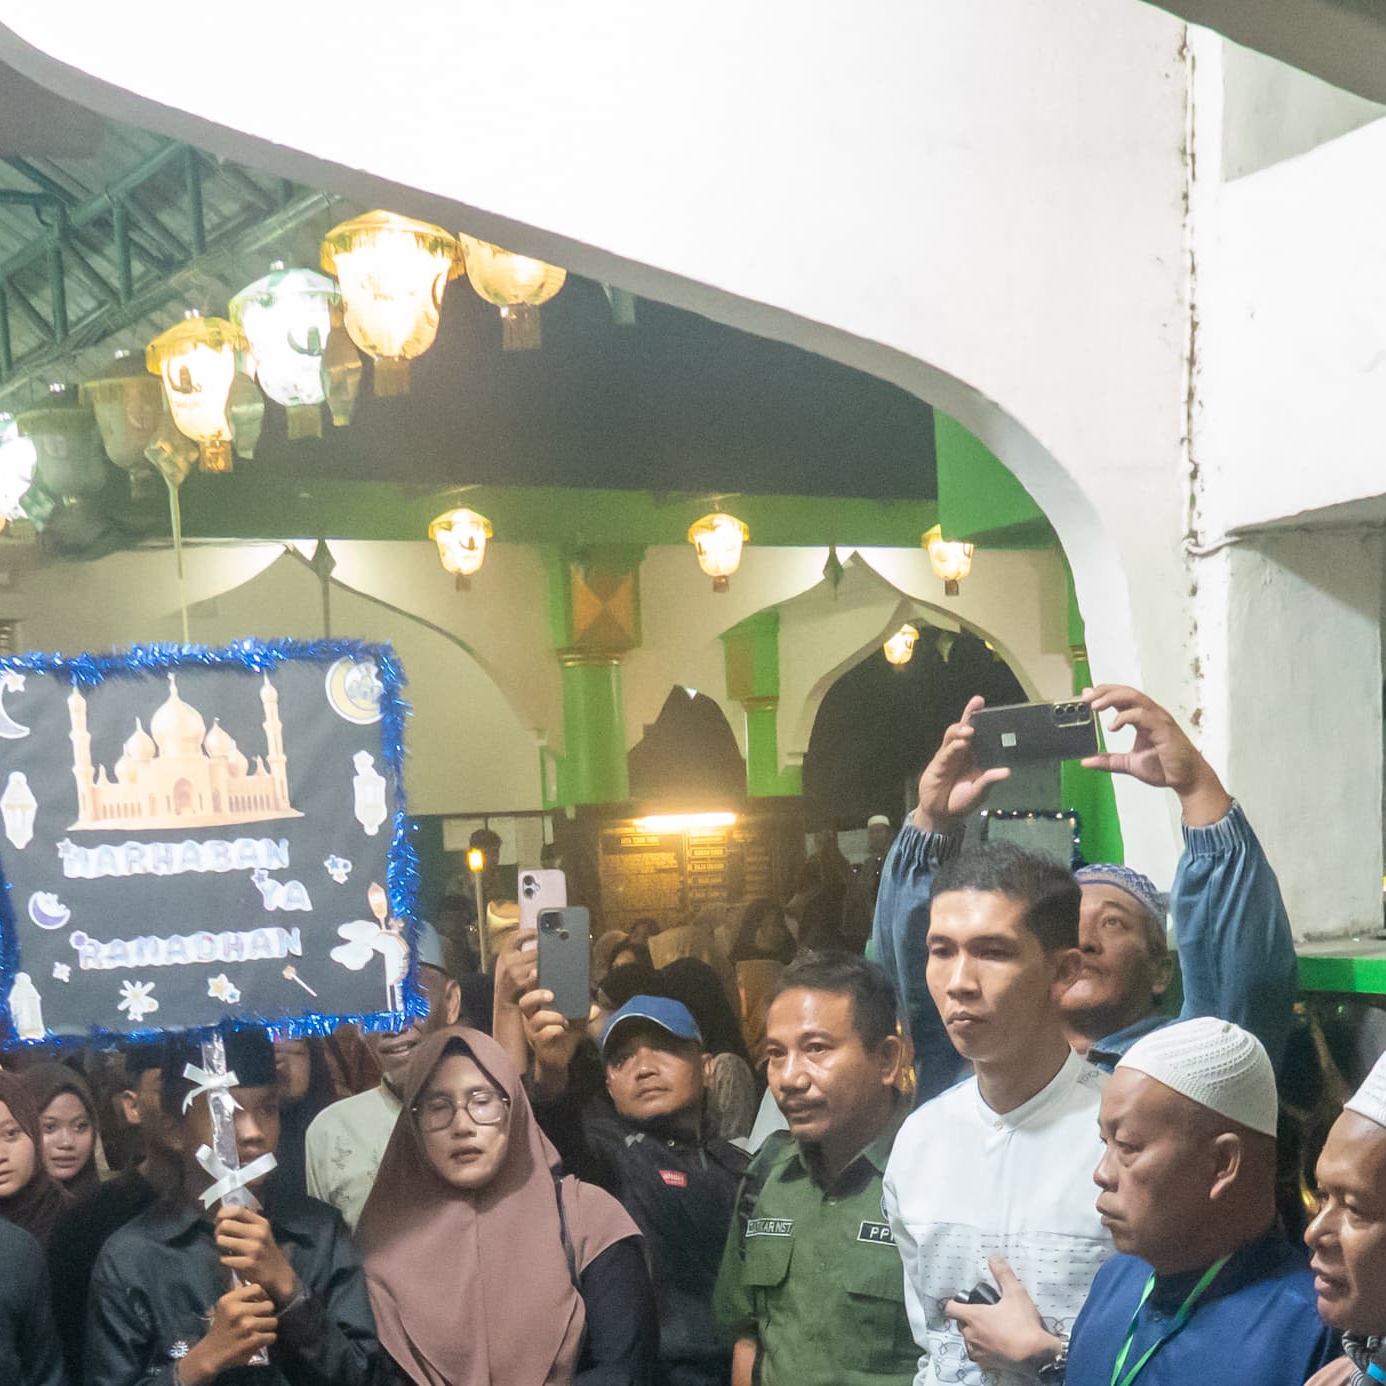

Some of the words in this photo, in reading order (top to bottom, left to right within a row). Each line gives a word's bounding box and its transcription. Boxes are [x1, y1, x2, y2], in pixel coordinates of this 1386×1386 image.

[65, 838, 290, 878] MARHABAN
[258, 877, 313, 911] YA
[78, 927, 303, 971] RAMADHAN
